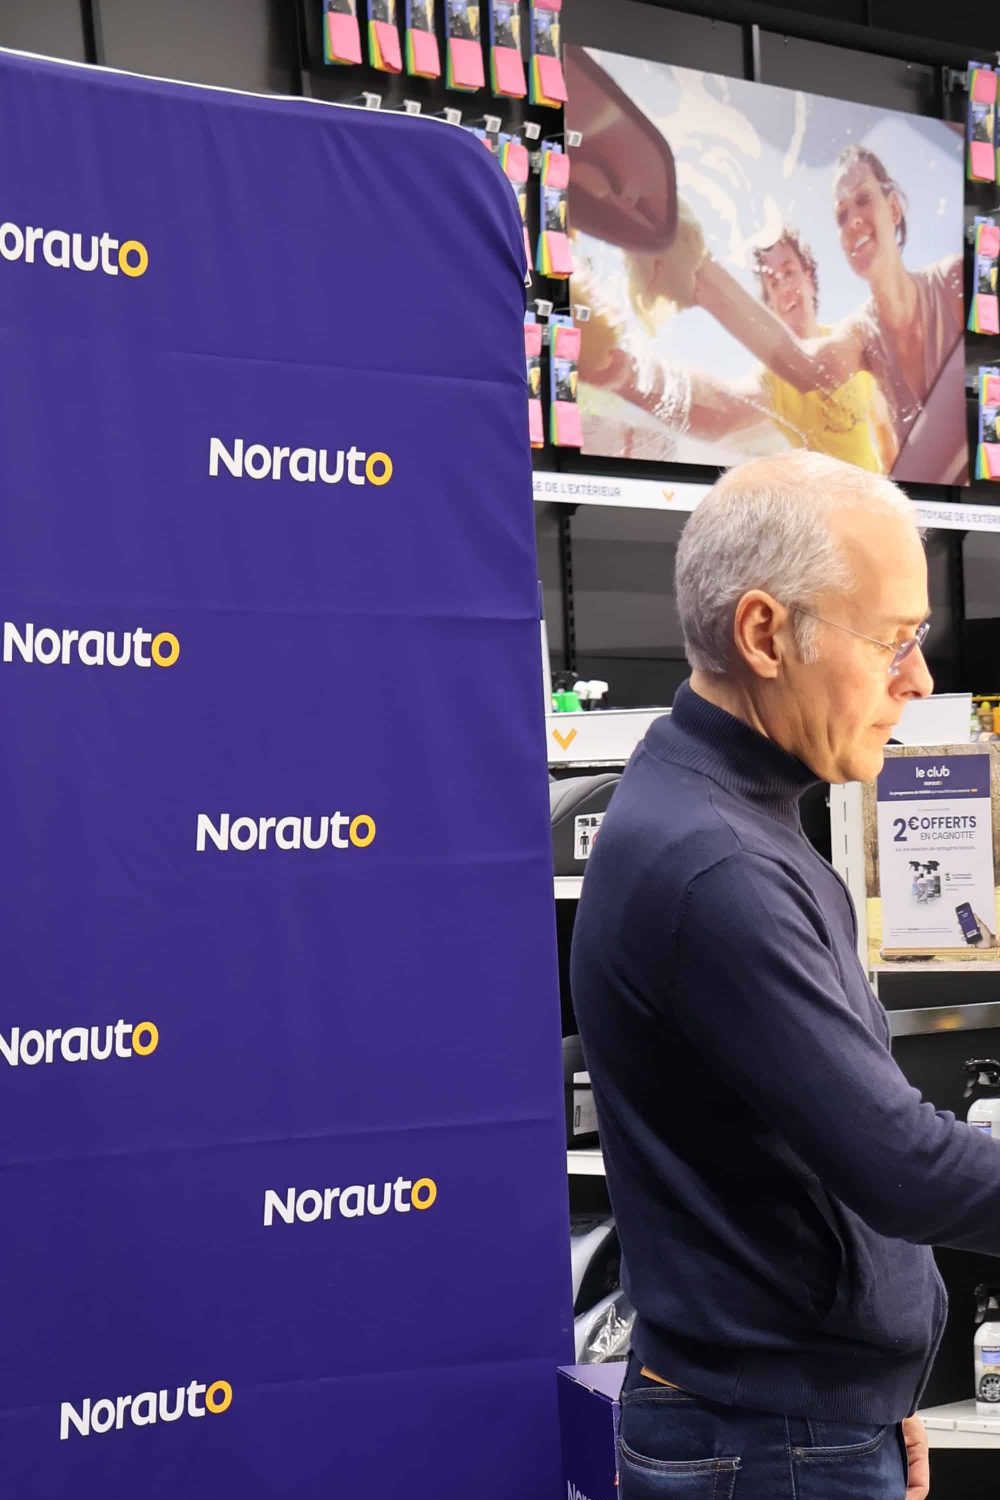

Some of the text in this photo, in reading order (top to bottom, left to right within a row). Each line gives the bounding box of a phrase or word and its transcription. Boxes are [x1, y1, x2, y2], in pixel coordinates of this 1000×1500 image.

[0, 222, 148, 277] orauto
[209, 438, 393, 485] Norauto
[4, 622, 180, 667] Norauto
[915, 765, 950, 778] le club
[196, 811, 376, 851] Norauto
[920, 815, 977, 830] OFFERTS
[920, 832, 931, 841] EN
[0, 1019, 158, 1066] Norauto
[264, 1177, 437, 1226] Norauto
[60, 1381, 232, 1440] Norauto
